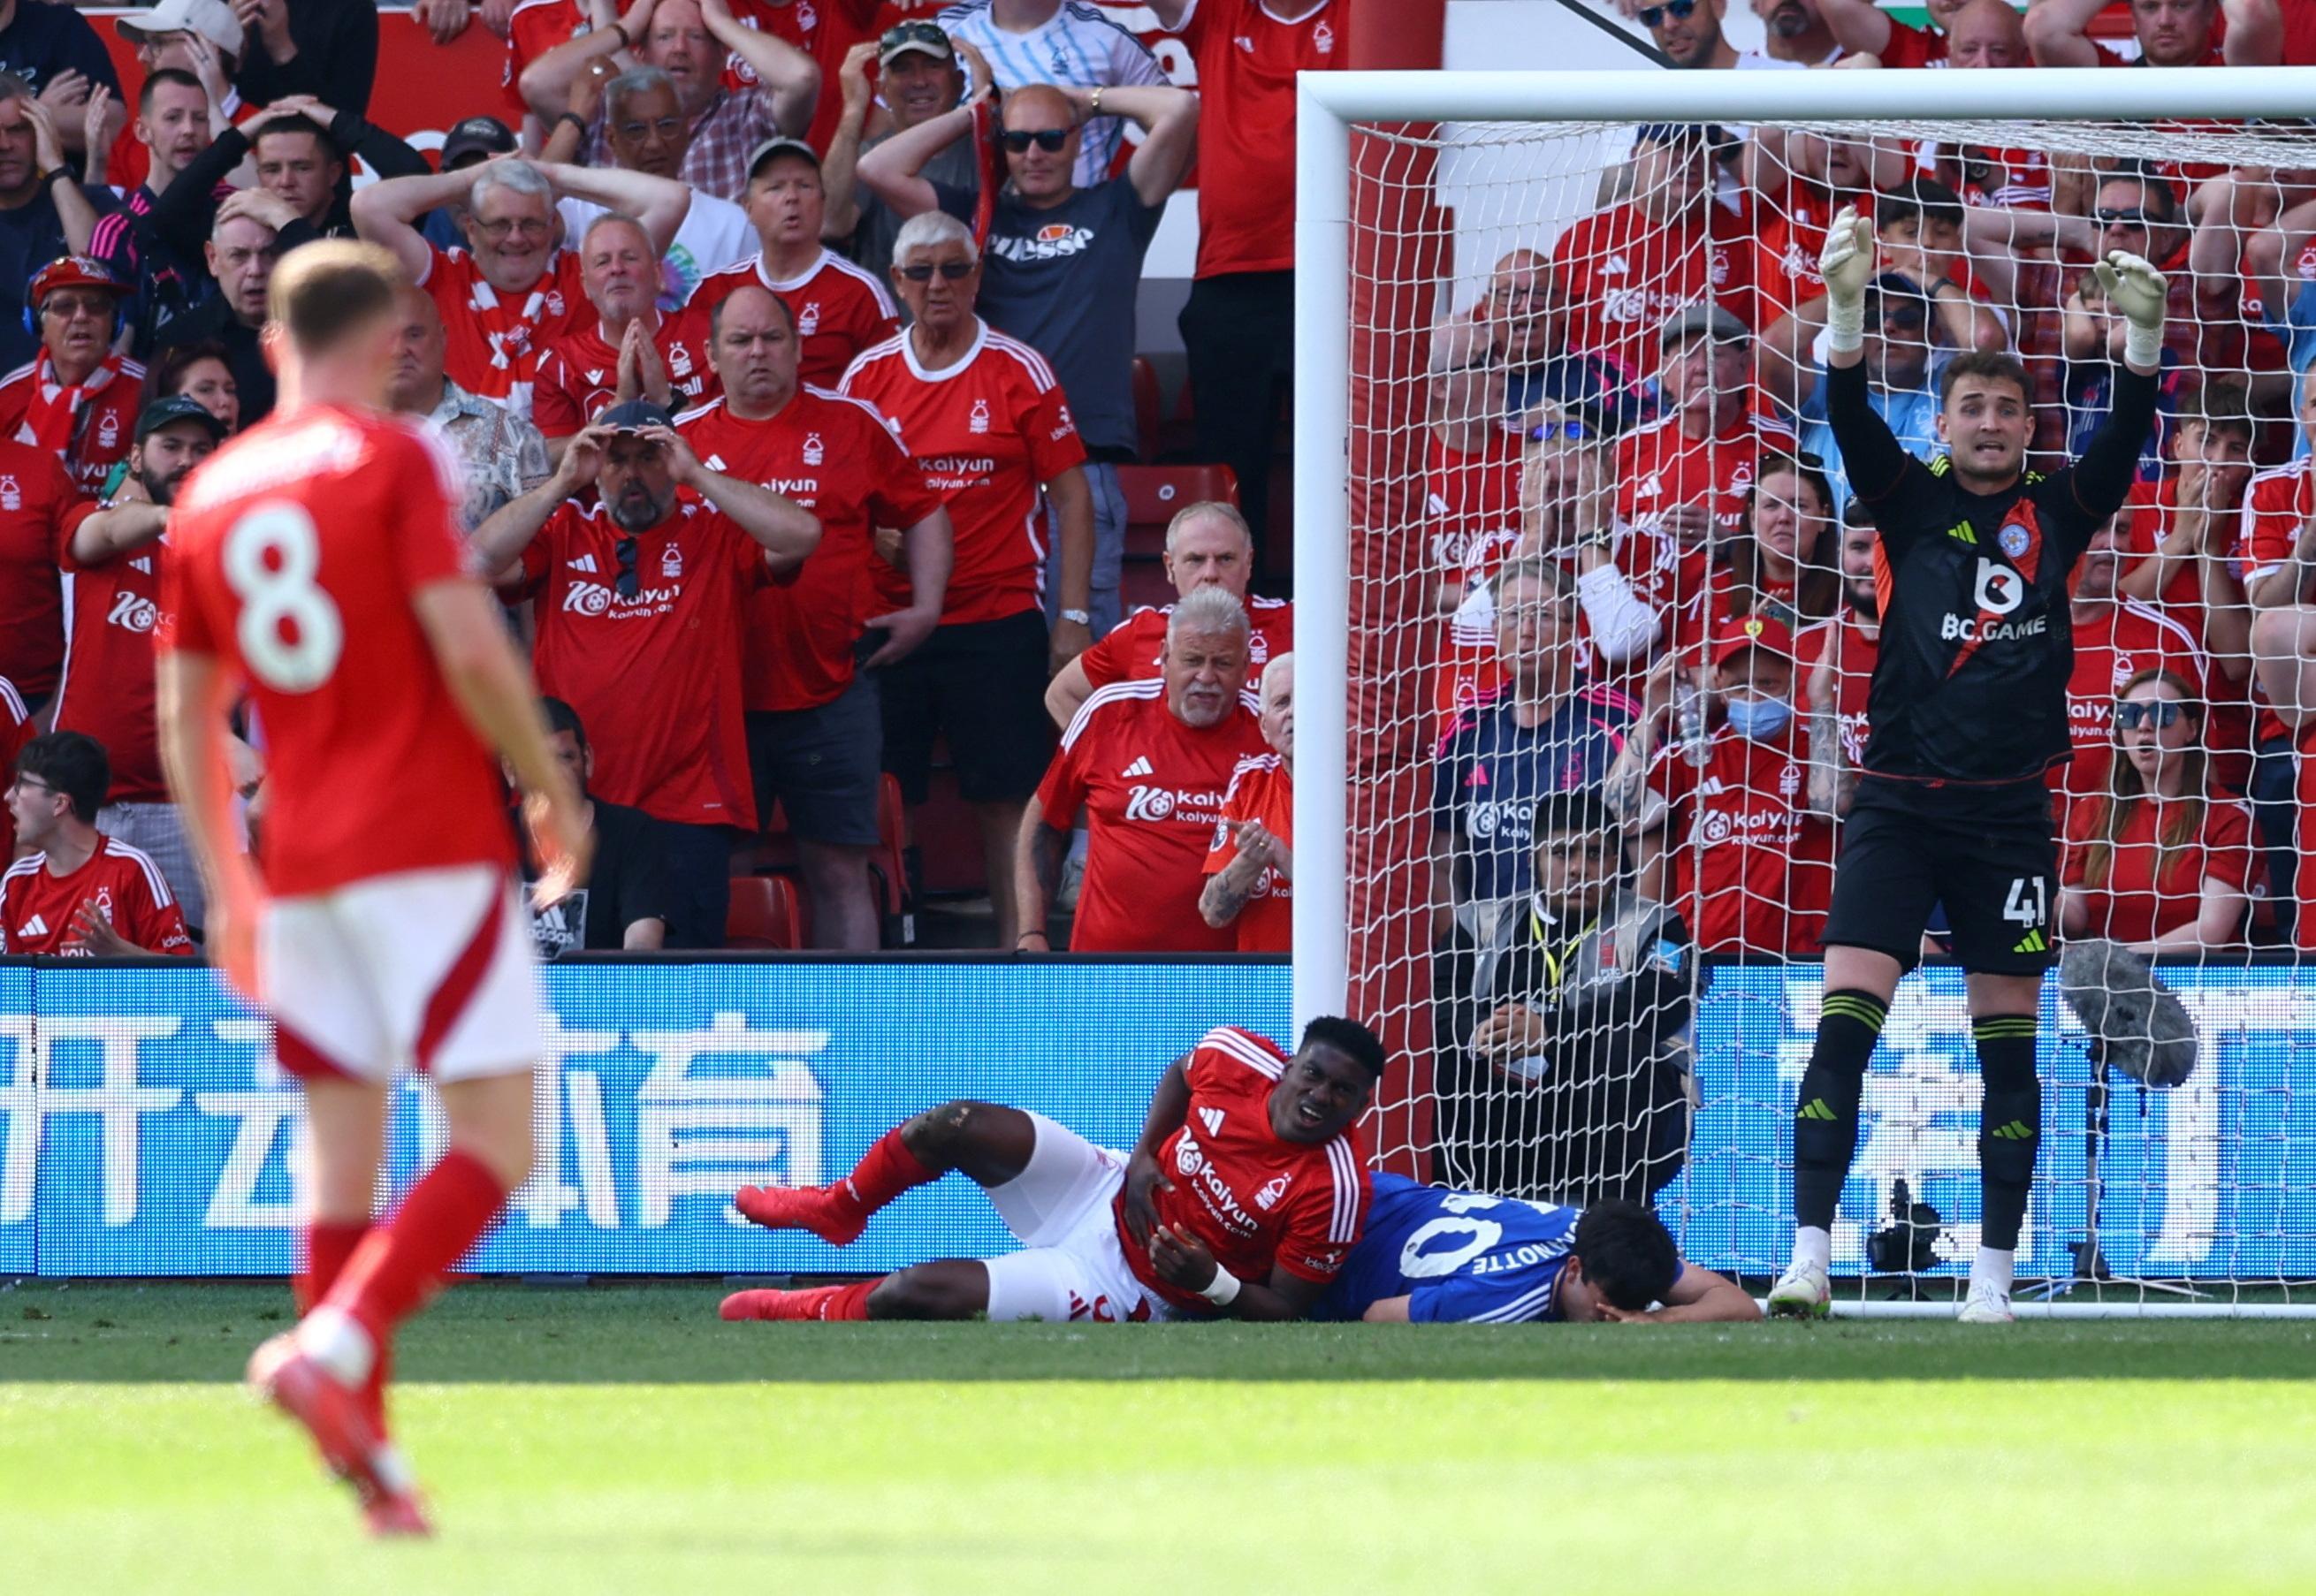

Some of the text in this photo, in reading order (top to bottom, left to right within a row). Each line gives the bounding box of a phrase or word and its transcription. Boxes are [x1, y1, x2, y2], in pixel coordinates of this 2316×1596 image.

[760, 478, 818, 495] iyun
[222, 498, 343, 694] 8
[1176, 789, 1227, 810] kaiy
[2003, 876, 2046, 929] 41
